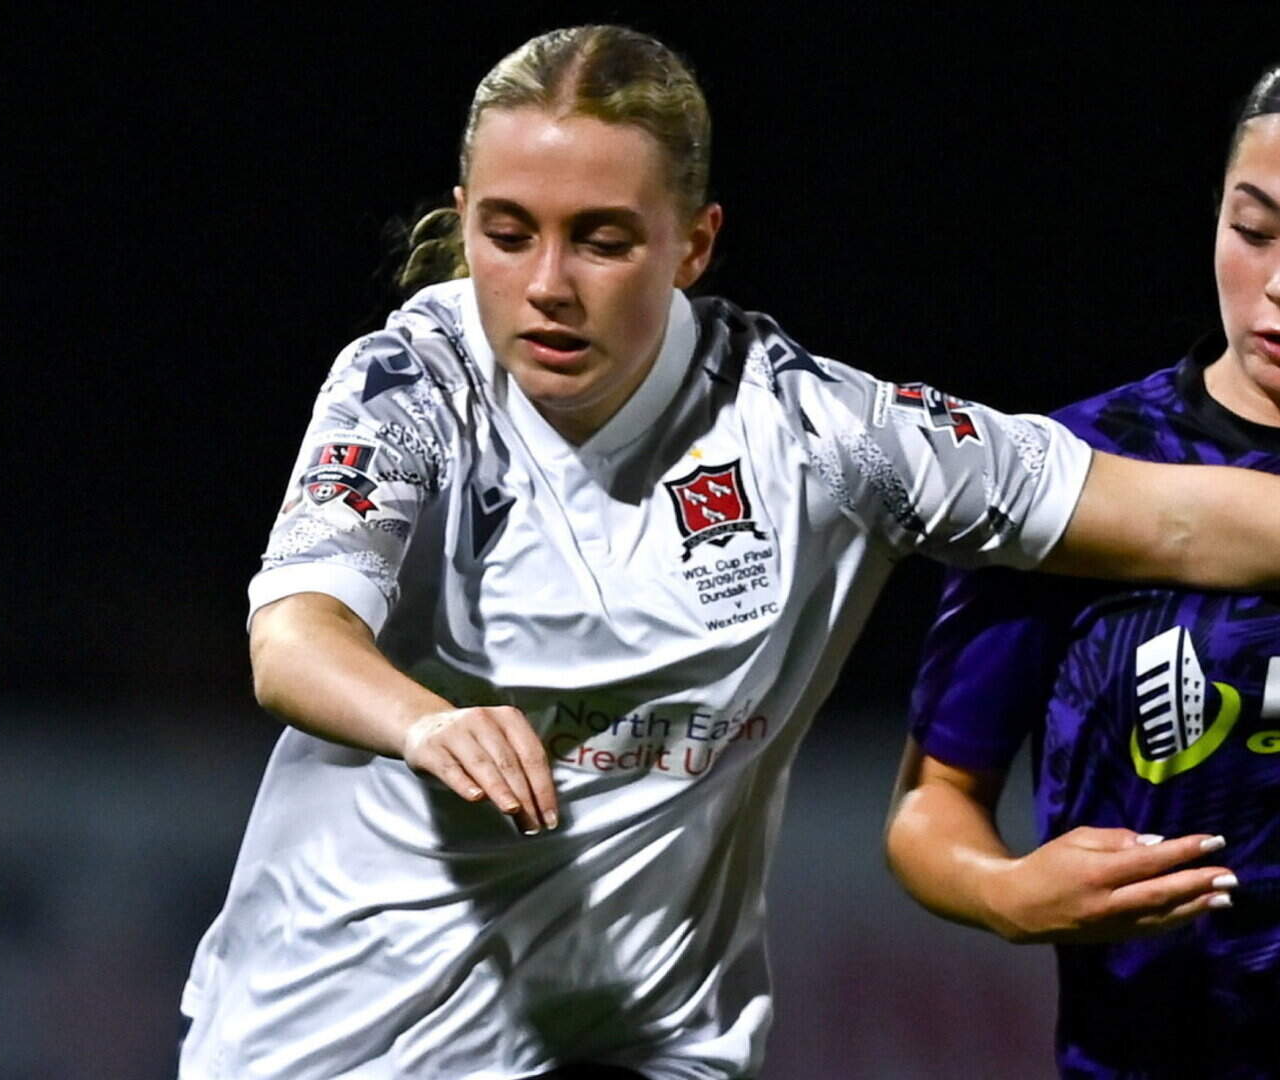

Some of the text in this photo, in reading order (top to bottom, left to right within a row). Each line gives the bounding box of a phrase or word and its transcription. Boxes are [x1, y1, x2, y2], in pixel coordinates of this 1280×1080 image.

[715, 558, 741, 572] Cup
[743, 547, 773, 563] Final
[700, 576, 769, 605] Dundalk FC
[705, 602, 779, 631] Wexford FC
[554, 700, 671, 739] North
[550, 733, 671, 772] Credit
